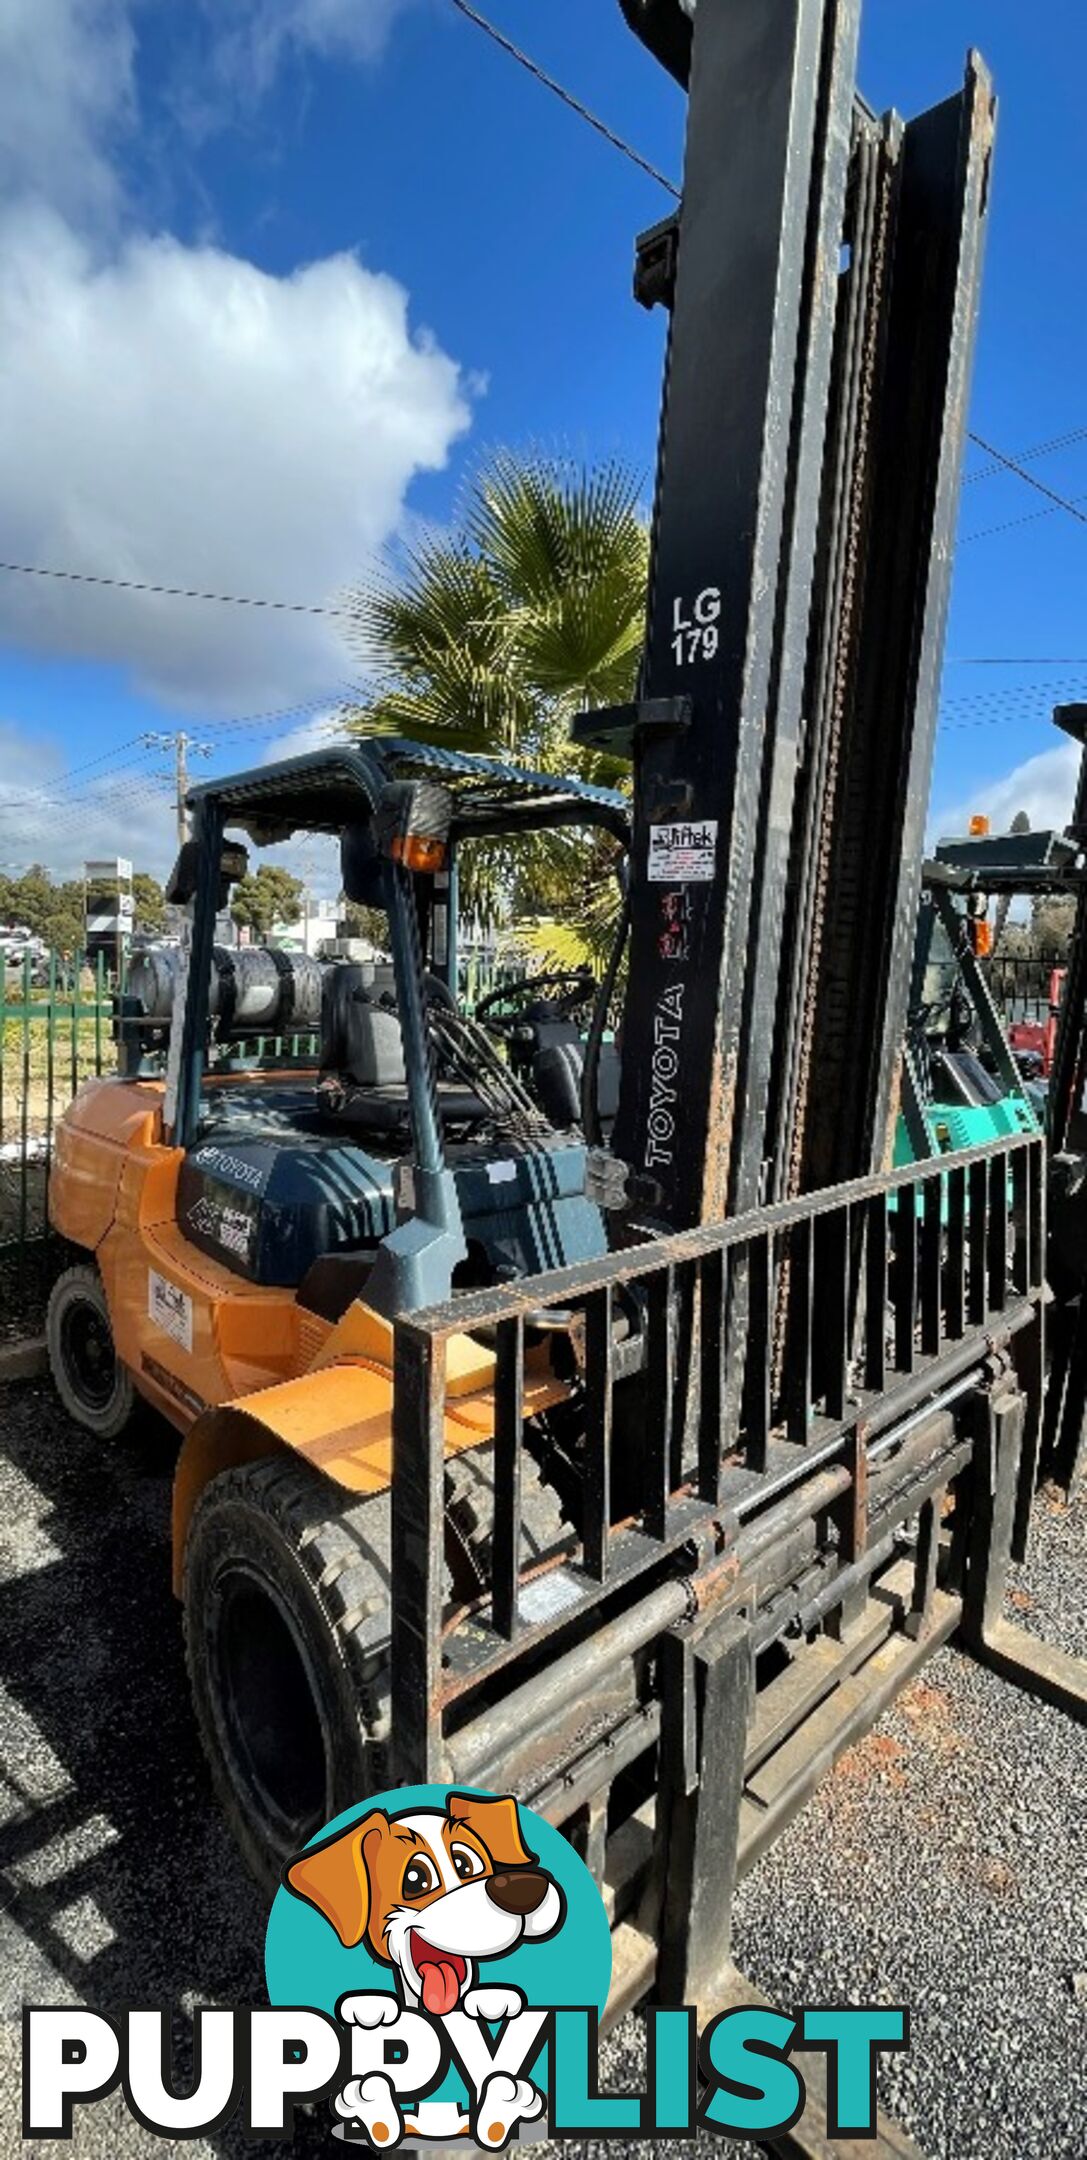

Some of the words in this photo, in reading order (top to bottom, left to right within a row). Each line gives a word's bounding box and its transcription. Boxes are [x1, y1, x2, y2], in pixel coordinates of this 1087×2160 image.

[673, 587, 721, 632] LG
[671, 625, 719, 666] 179
[645, 983, 685, 1168] TOYOTA
[214, 1151, 264, 1188] TOYOTA
